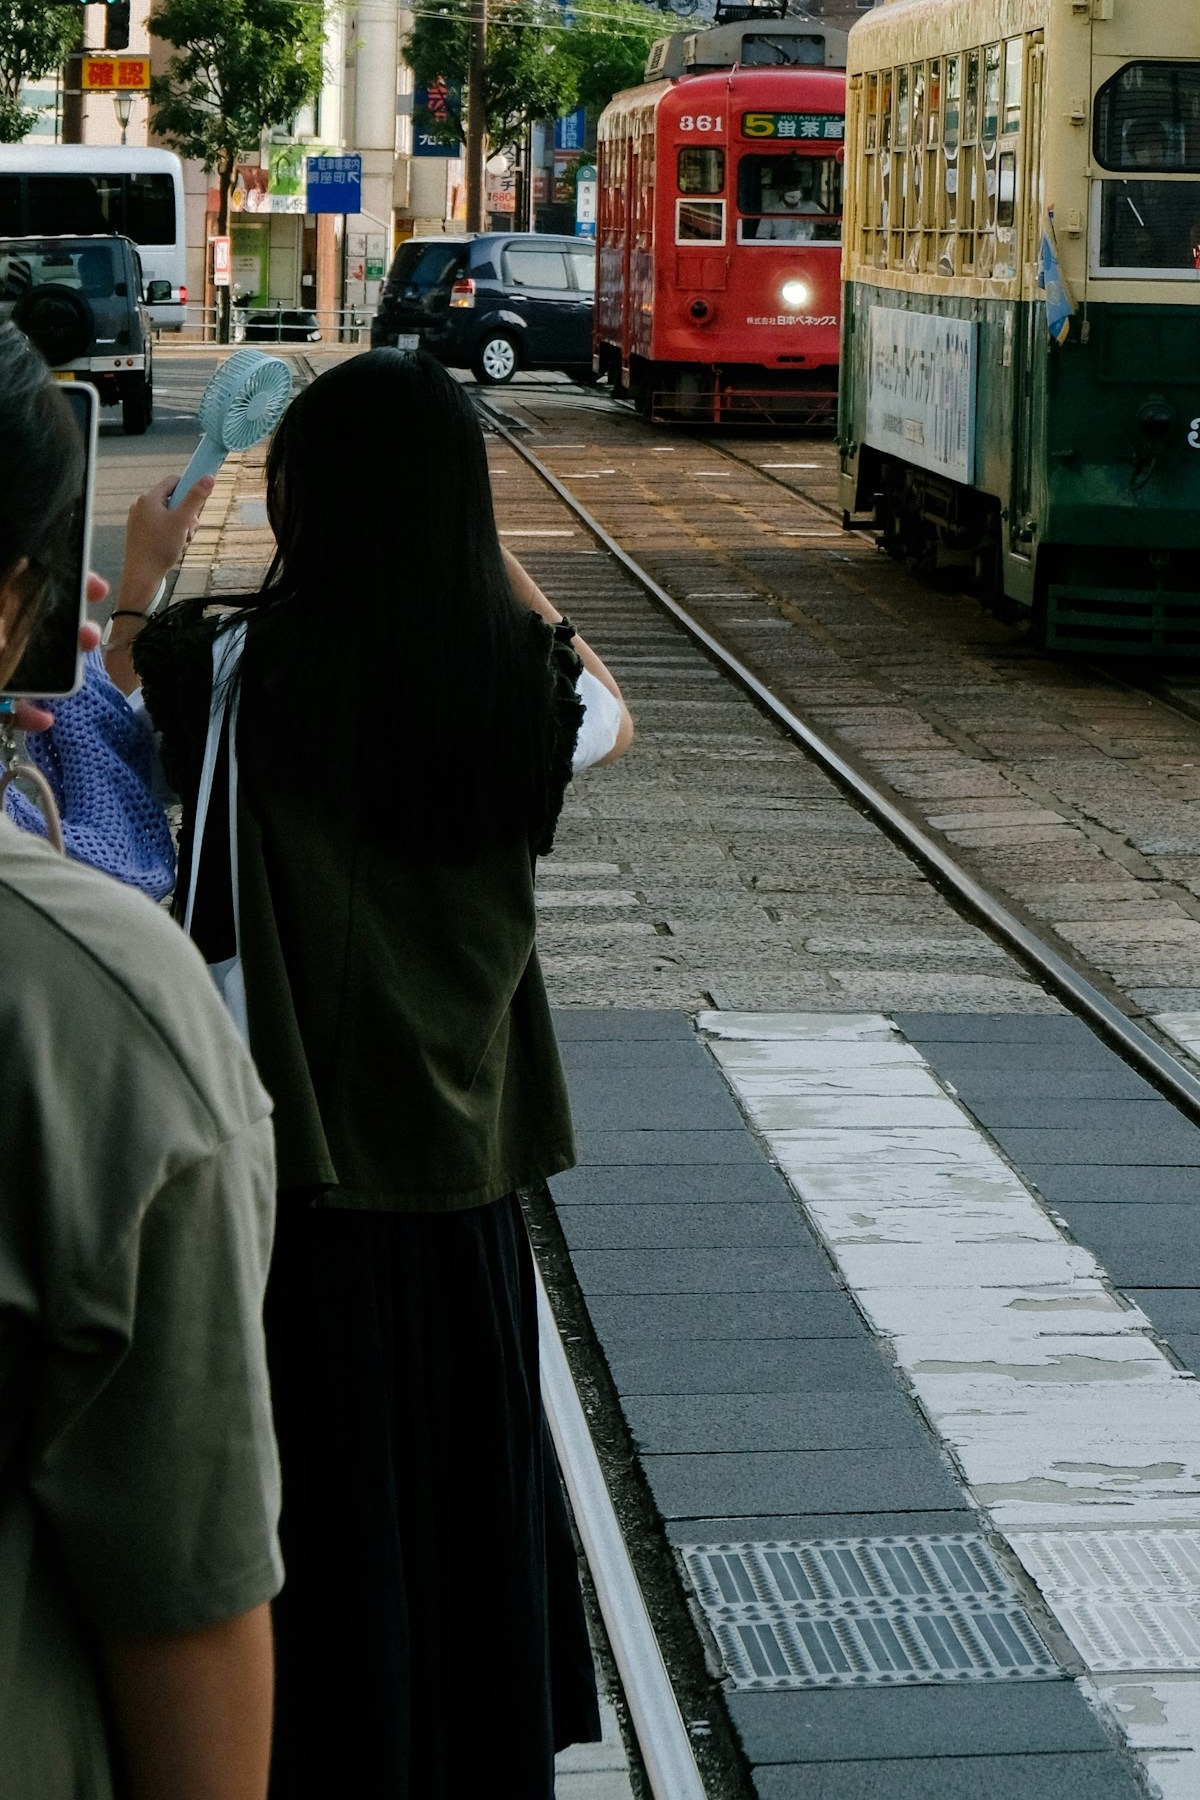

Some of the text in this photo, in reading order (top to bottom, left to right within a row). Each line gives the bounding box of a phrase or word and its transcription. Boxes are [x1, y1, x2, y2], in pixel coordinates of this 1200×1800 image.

[88, 62, 144, 86] 確認
[679, 115, 723, 132] 361
[745, 114, 845, 138] 5 蛍茶屋
